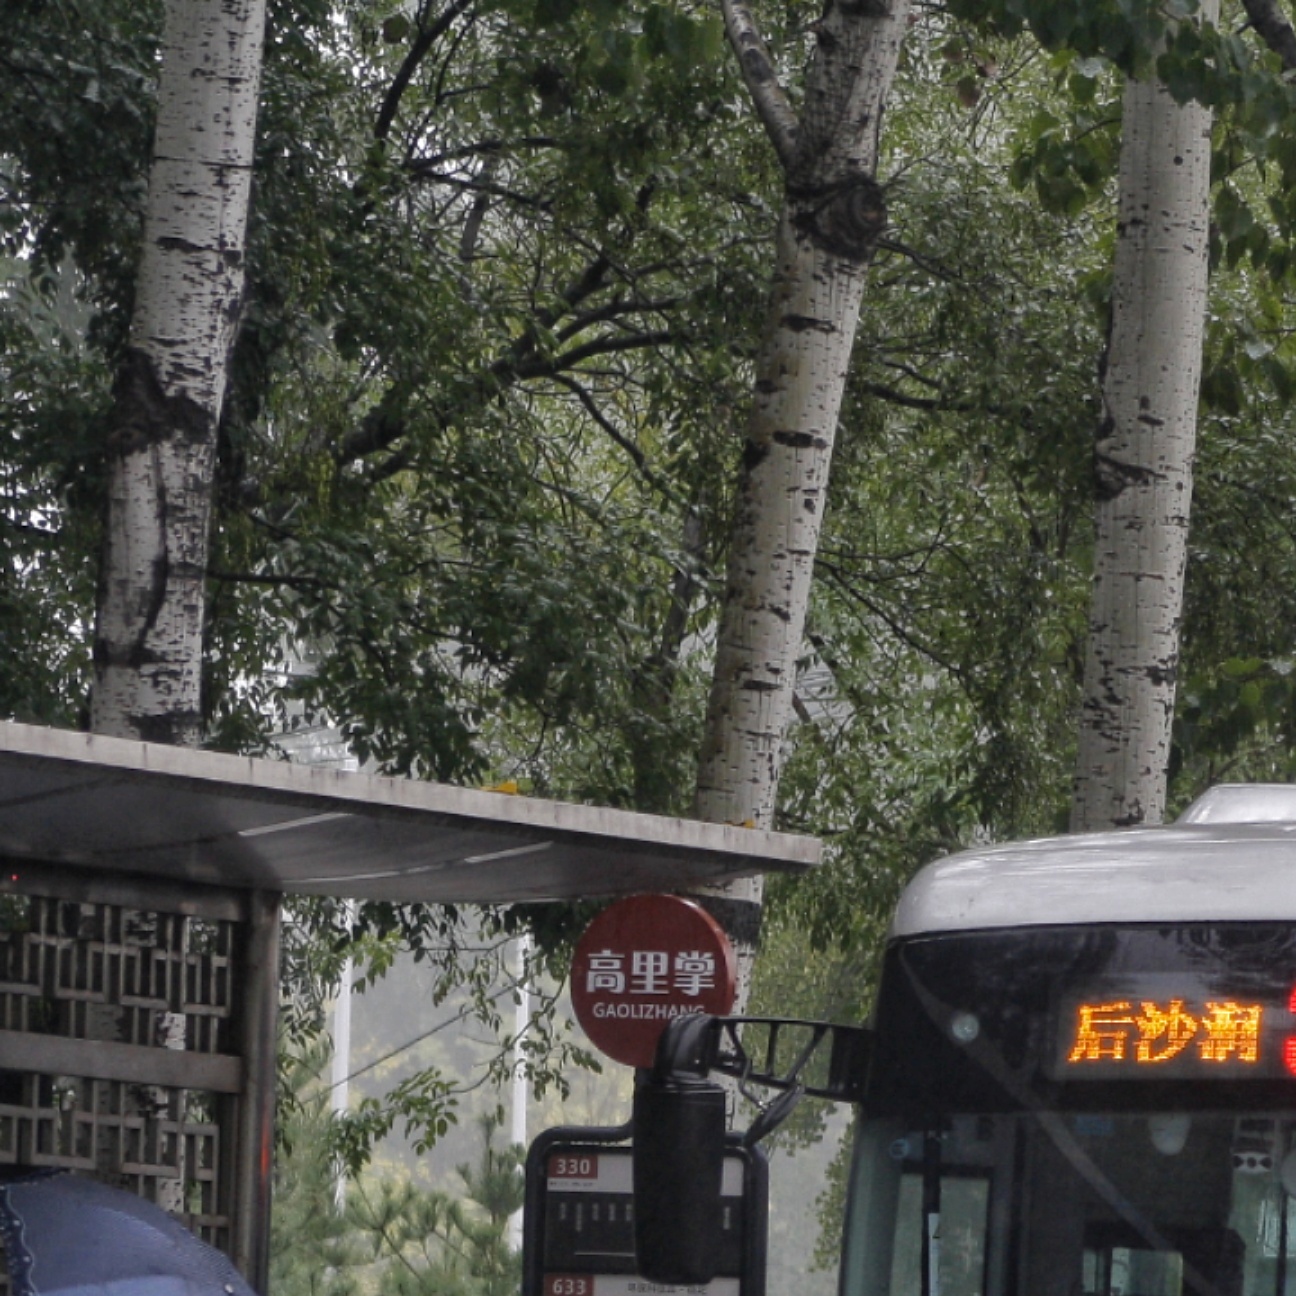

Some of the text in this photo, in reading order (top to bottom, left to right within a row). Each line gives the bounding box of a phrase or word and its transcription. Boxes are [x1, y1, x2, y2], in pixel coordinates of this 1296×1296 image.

[586, 949, 715, 996] 高里掌
[1068, 1000, 1261, 1062] 后沙涧
[556, 1159, 590, 1175] 330
[552, 1279, 586, 1296] 633
